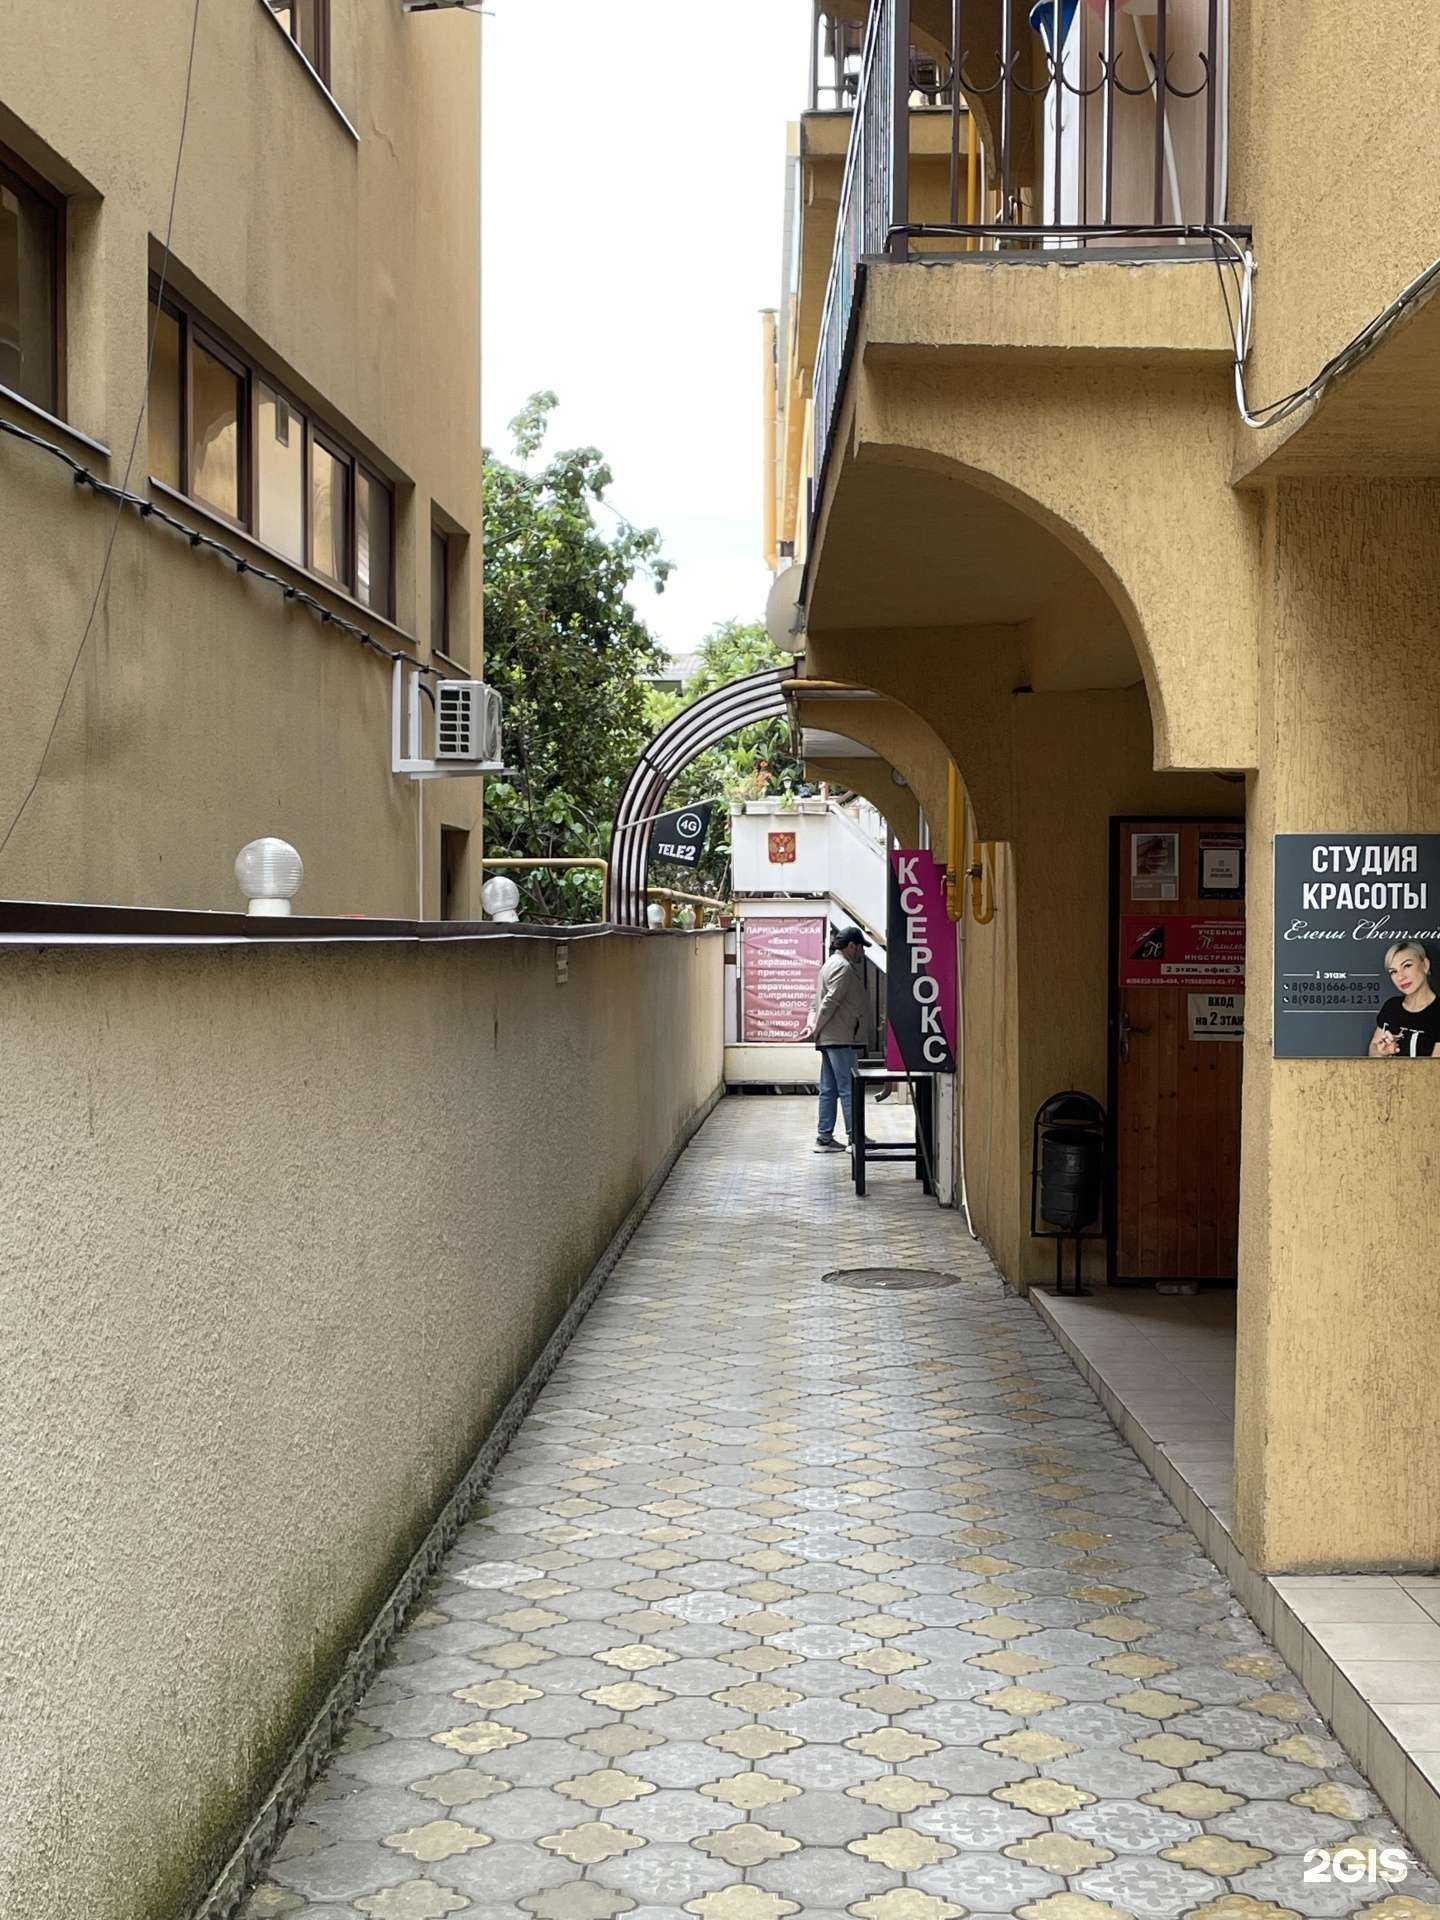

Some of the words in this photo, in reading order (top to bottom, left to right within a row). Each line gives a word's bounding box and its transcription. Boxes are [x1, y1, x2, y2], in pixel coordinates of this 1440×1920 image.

[680, 819, 698, 832] 4G
[658, 843, 696, 861] TELE2
[1312, 845, 1418, 876] СТУДИЯ
[1302, 882, 1427, 910] КРАСОТЫ
[1283, 918, 1346, 941] Елены
[898, 856, 948, 1064] КСЕРОКС
[1315, 970, 1321, 980] 1
[1323, 971, 1347, 980] этаж
[1208, 996, 1235, 1009] ВХОД
[1195, 1016, 1208, 1026] на
[1209, 1011, 1218, 1026] 2
